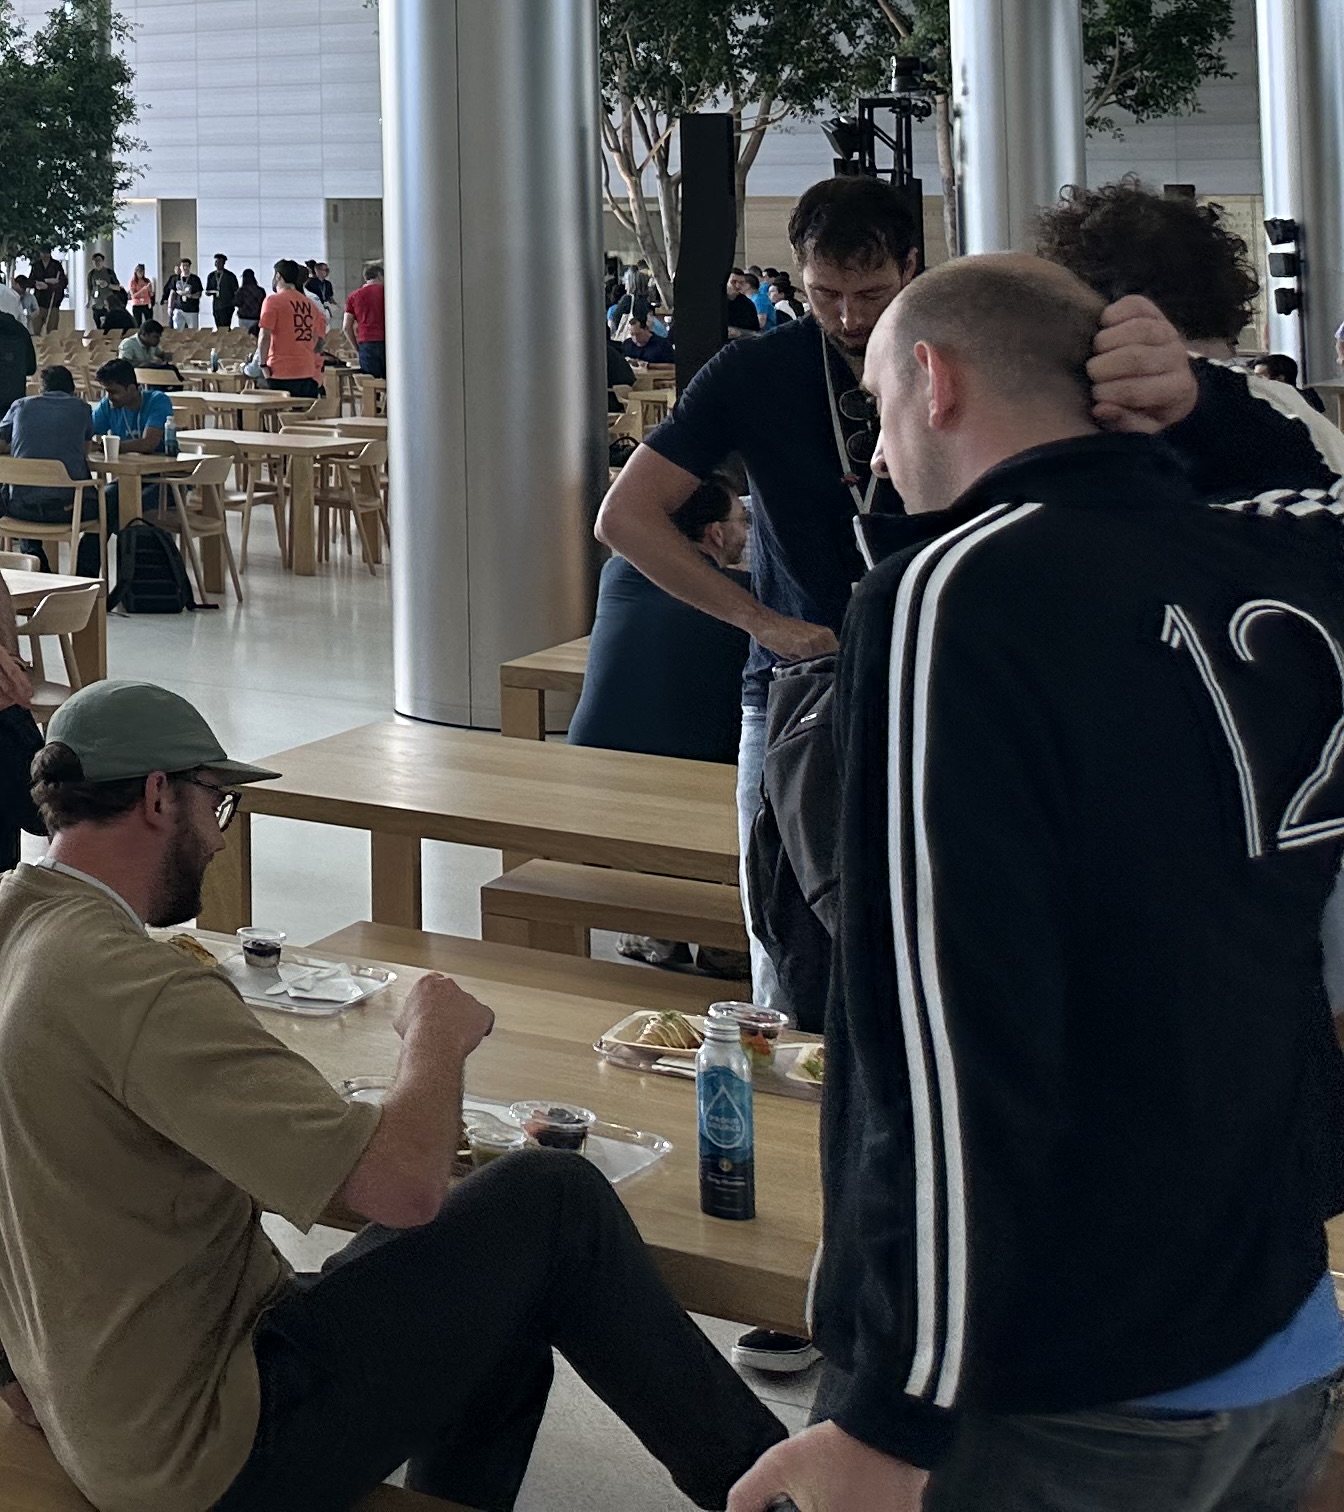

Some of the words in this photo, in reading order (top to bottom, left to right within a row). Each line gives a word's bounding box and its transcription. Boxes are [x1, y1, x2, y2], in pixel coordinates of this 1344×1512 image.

[294, 314, 313, 328] DC
[294, 328, 313, 341] 23
[1161, 599, 1344, 858] 12
